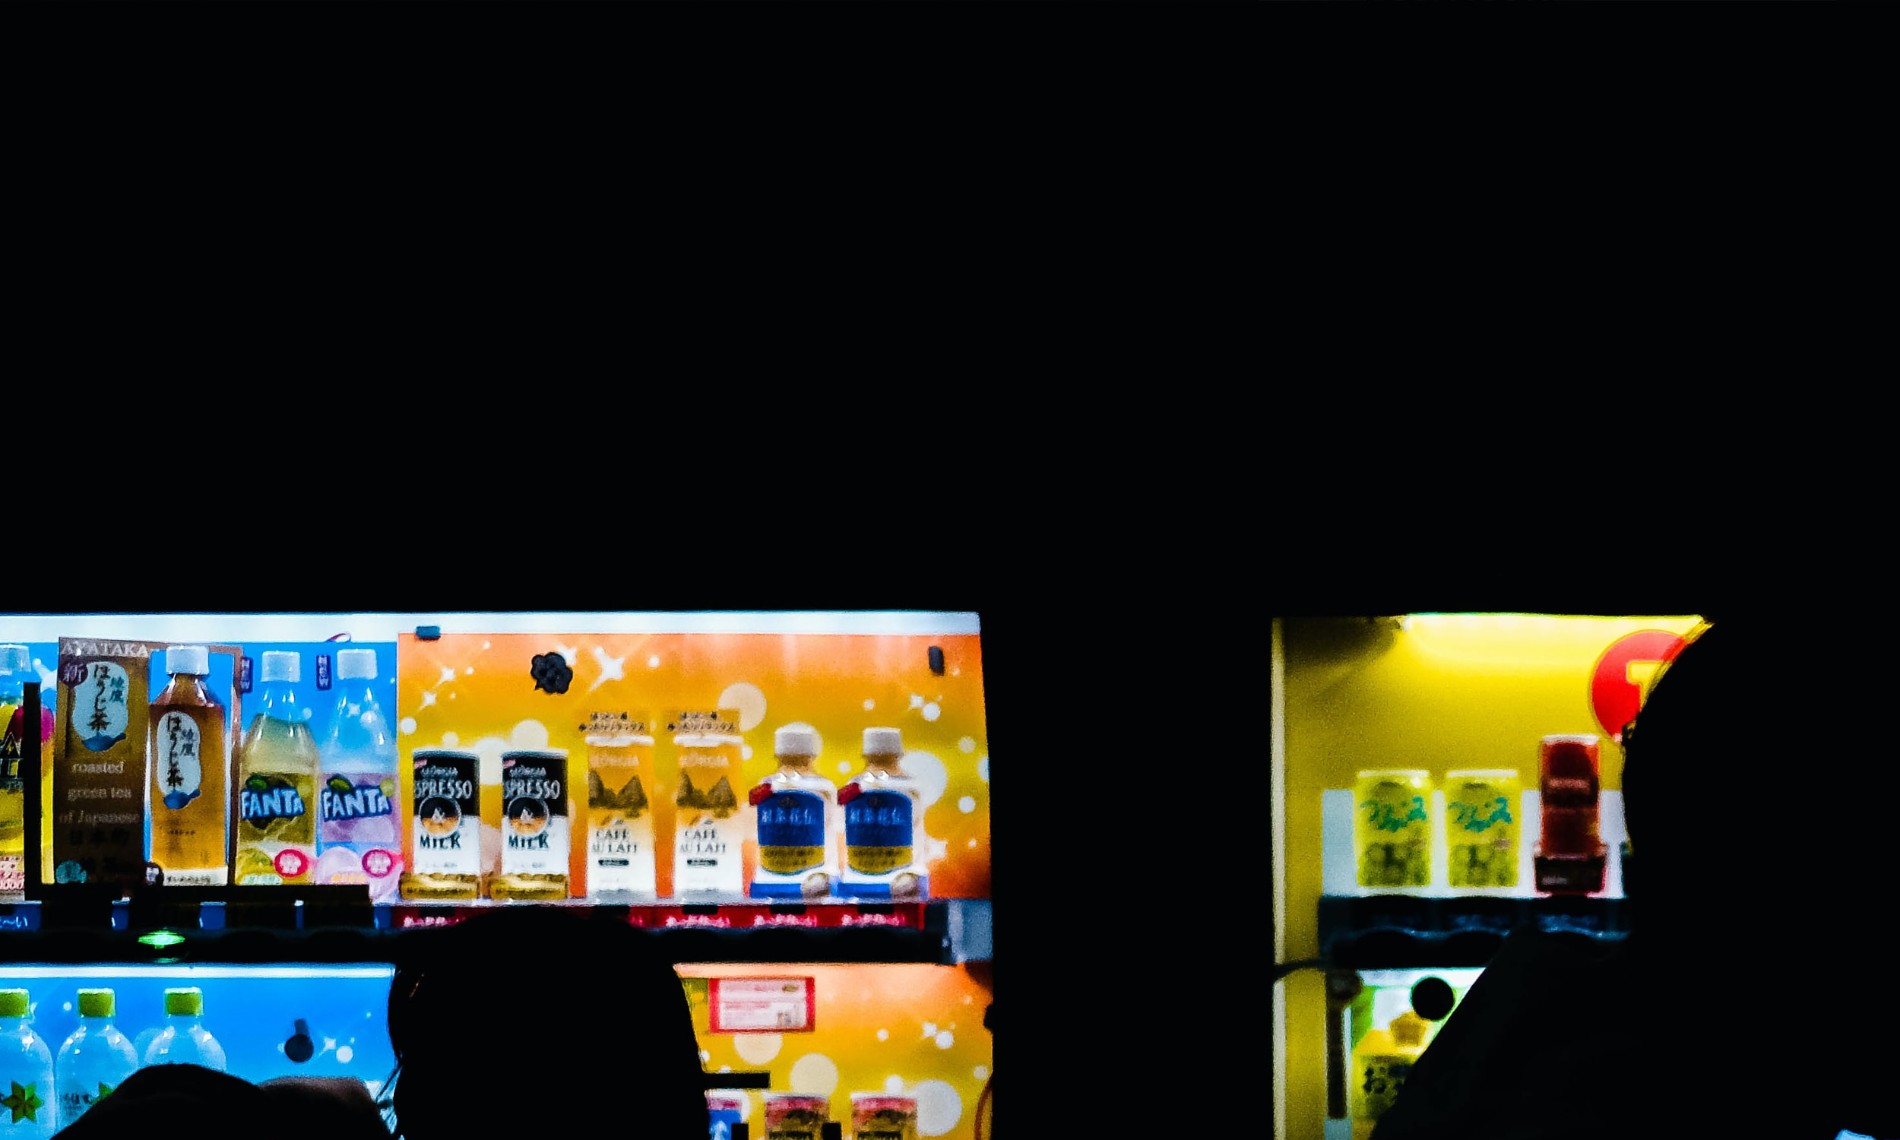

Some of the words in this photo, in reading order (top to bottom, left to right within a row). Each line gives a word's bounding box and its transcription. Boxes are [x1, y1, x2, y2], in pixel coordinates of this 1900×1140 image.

[61, 641, 149, 657] AYATAKA
[240, 787, 306, 819] FANTA
[322, 787, 391, 820] FANTA
